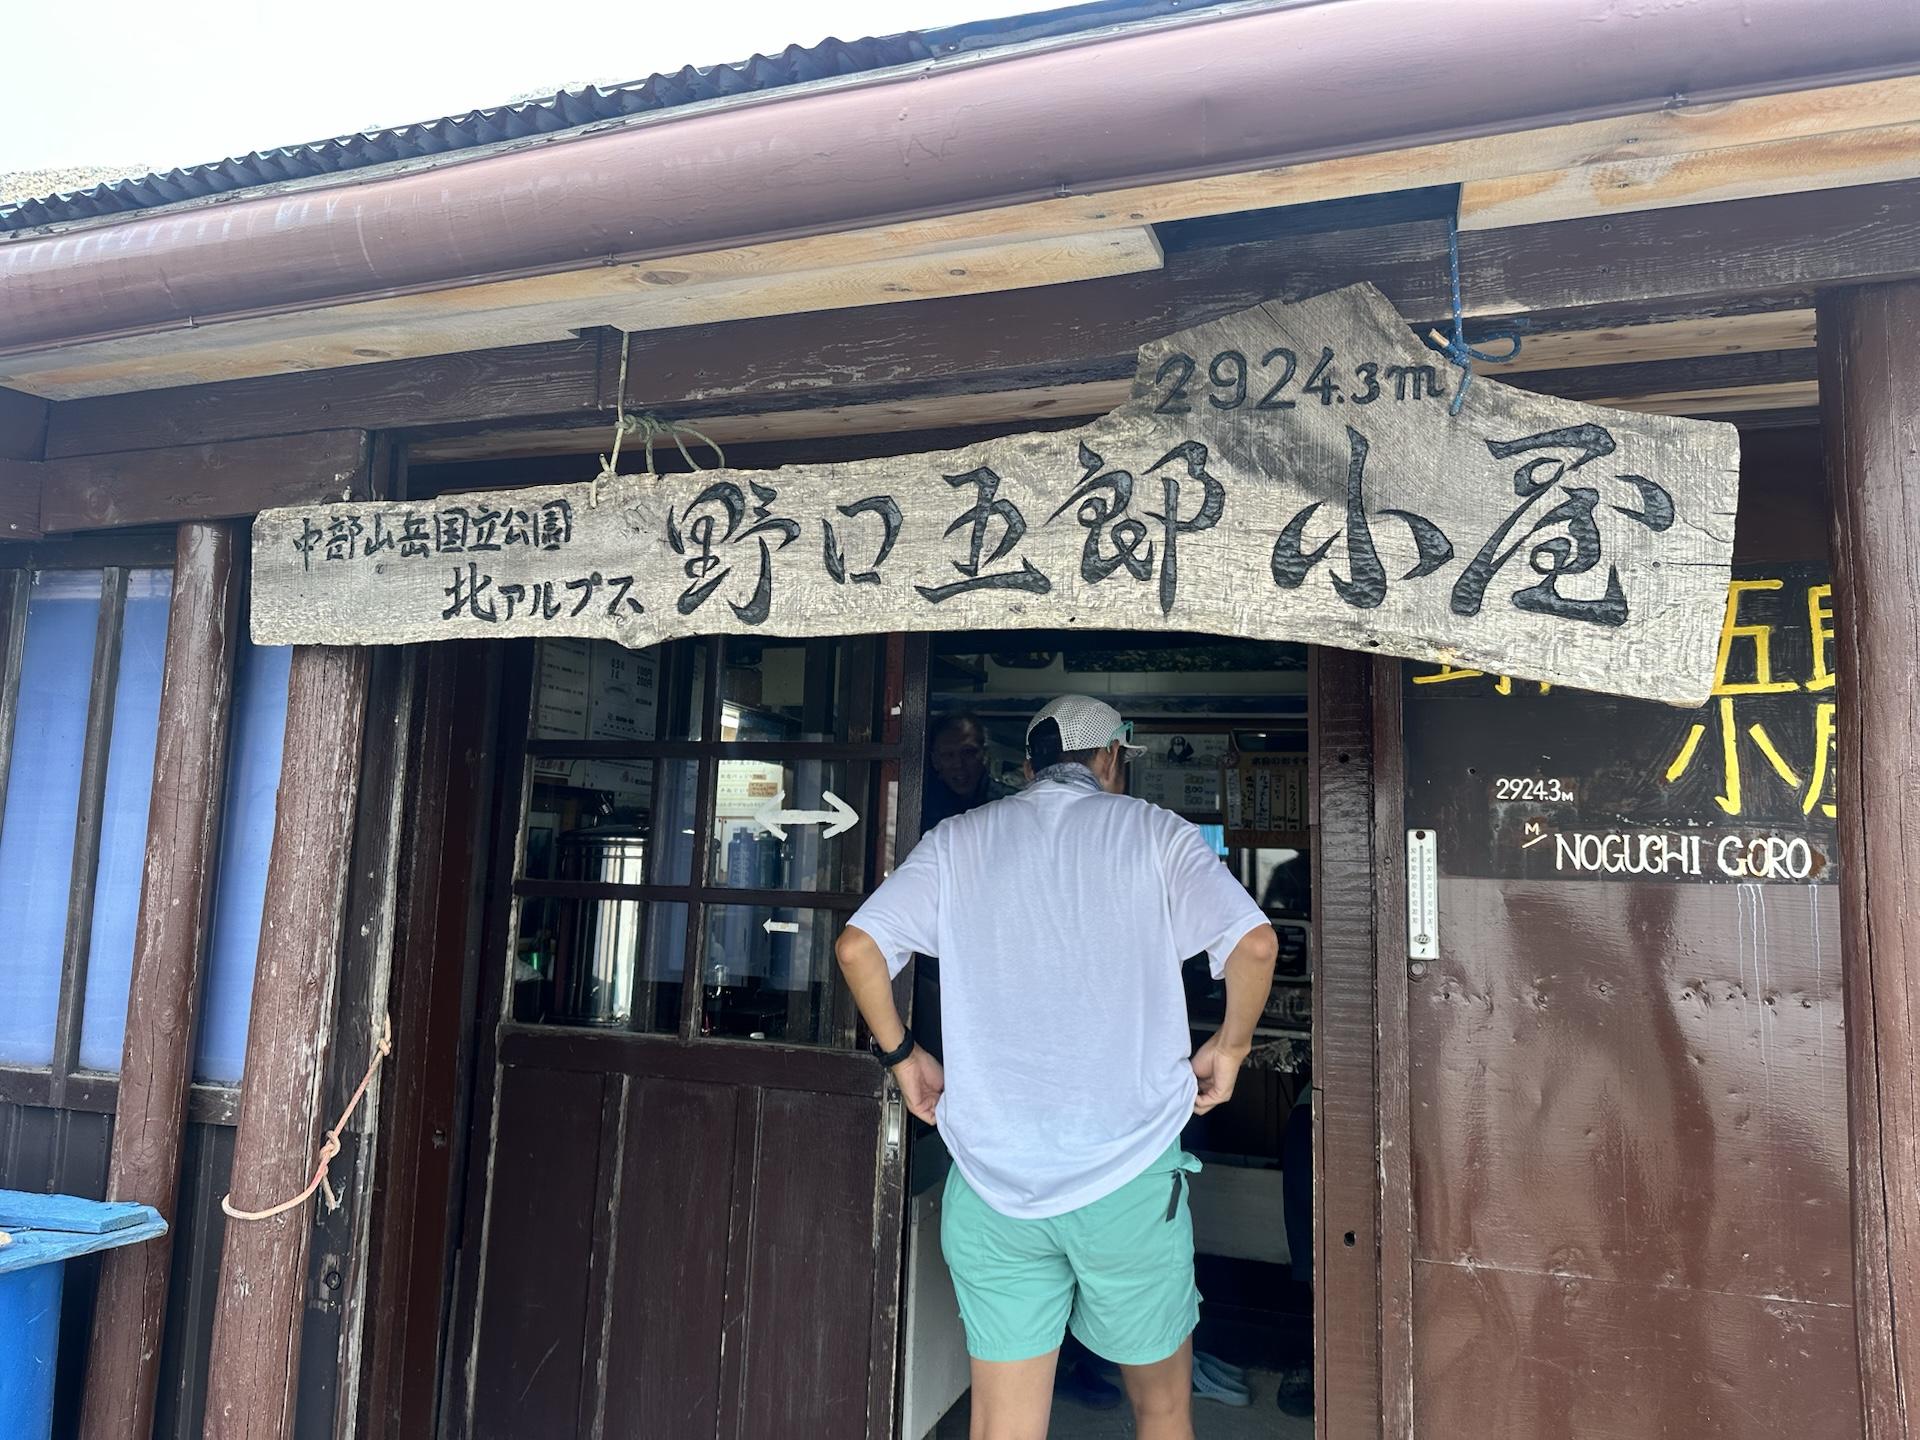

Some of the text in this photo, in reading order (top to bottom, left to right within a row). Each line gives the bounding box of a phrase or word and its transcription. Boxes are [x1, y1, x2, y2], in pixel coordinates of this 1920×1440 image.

[1153, 346, 1446, 415] 2924.3m
[292, 499, 573, 572] 中部山岳国立公園
[441, 562, 646, 624] 北アルプス
[1553, 832, 1702, 875] NOGUCHI
[1716, 834, 1813, 879] GORO
